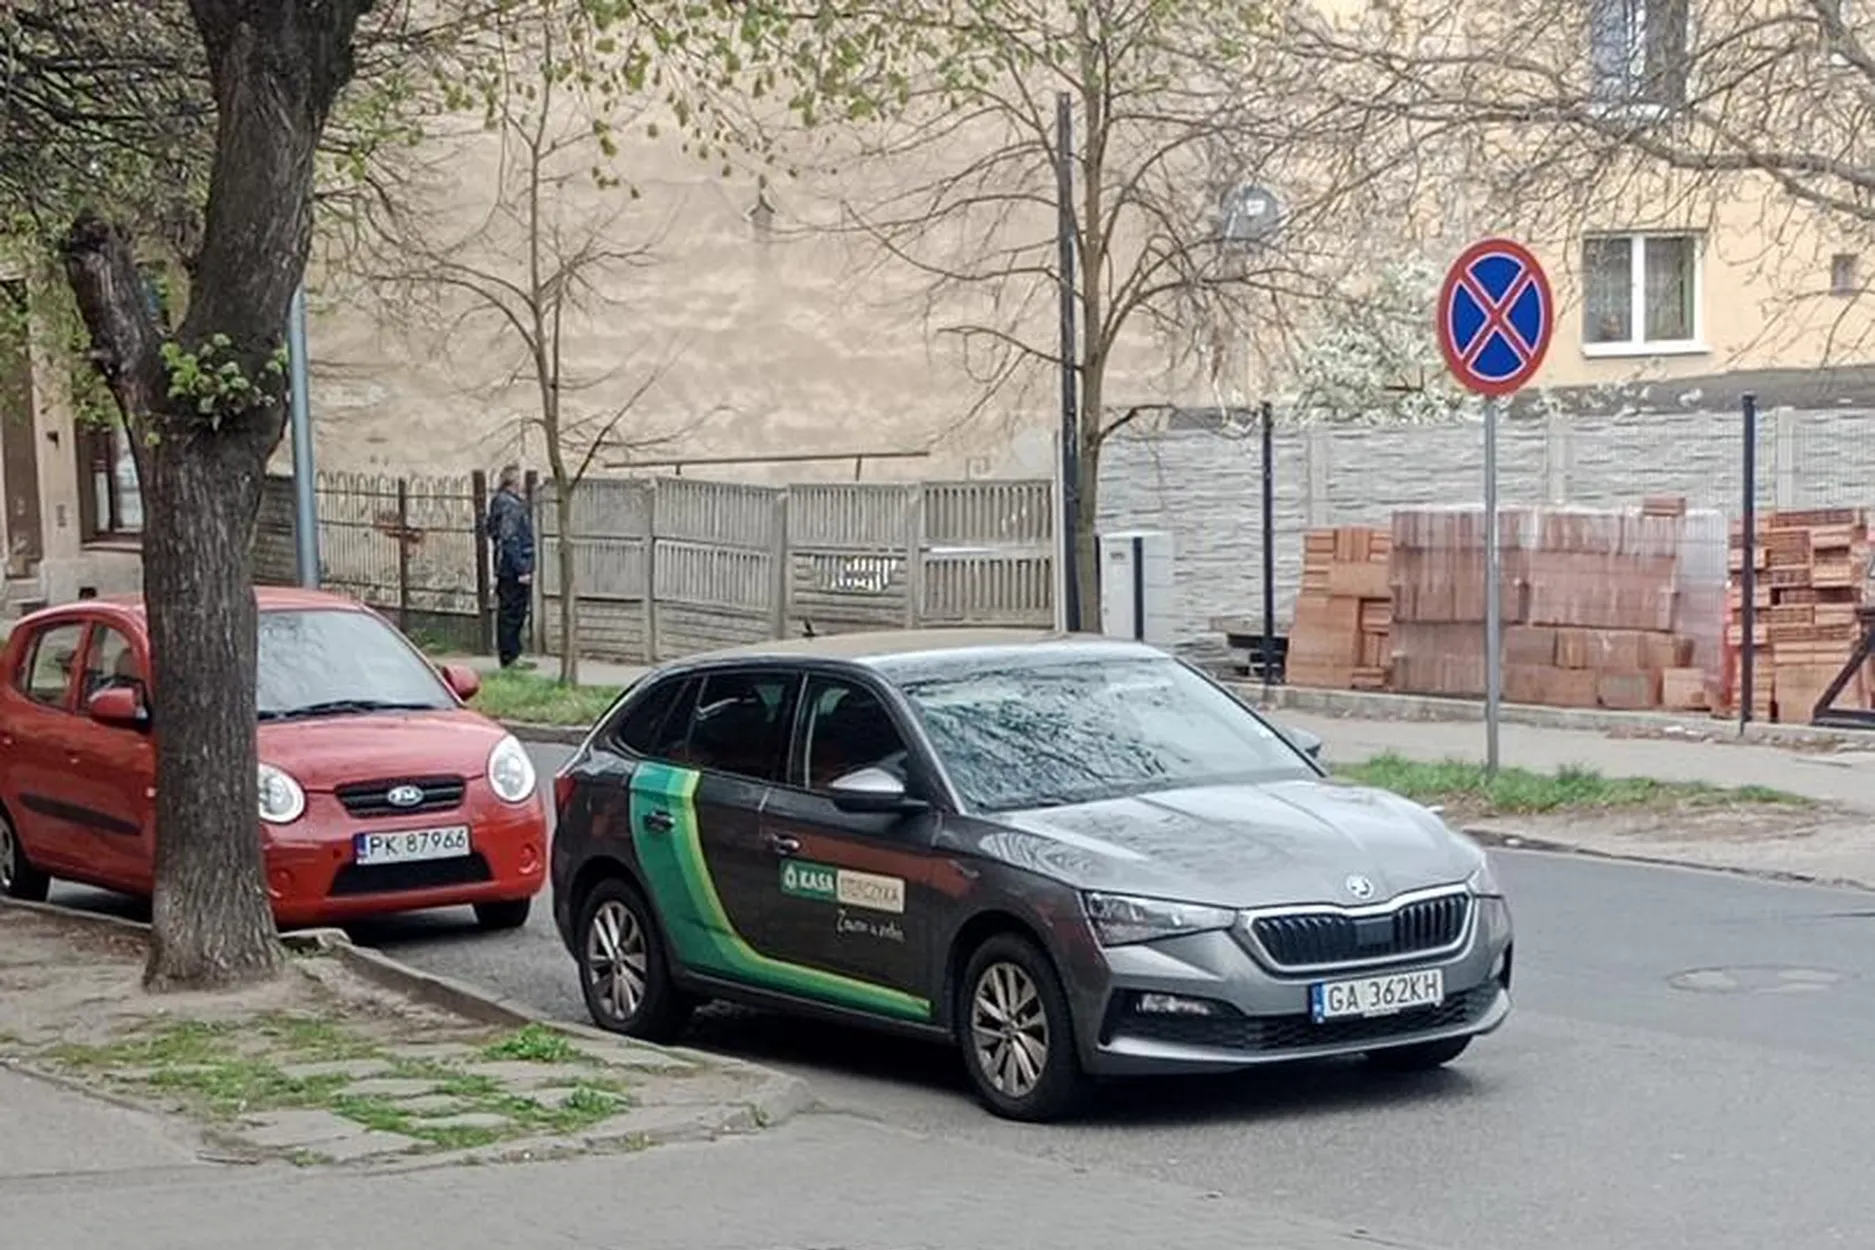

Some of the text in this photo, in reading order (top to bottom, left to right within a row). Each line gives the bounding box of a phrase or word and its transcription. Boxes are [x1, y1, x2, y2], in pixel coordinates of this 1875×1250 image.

[369, 831, 467, 855] PK 87966
[800, 869, 834, 892] KASA
[1329, 985, 1359, 1012] GA
[1369, 972, 1438, 1007] 362KH
